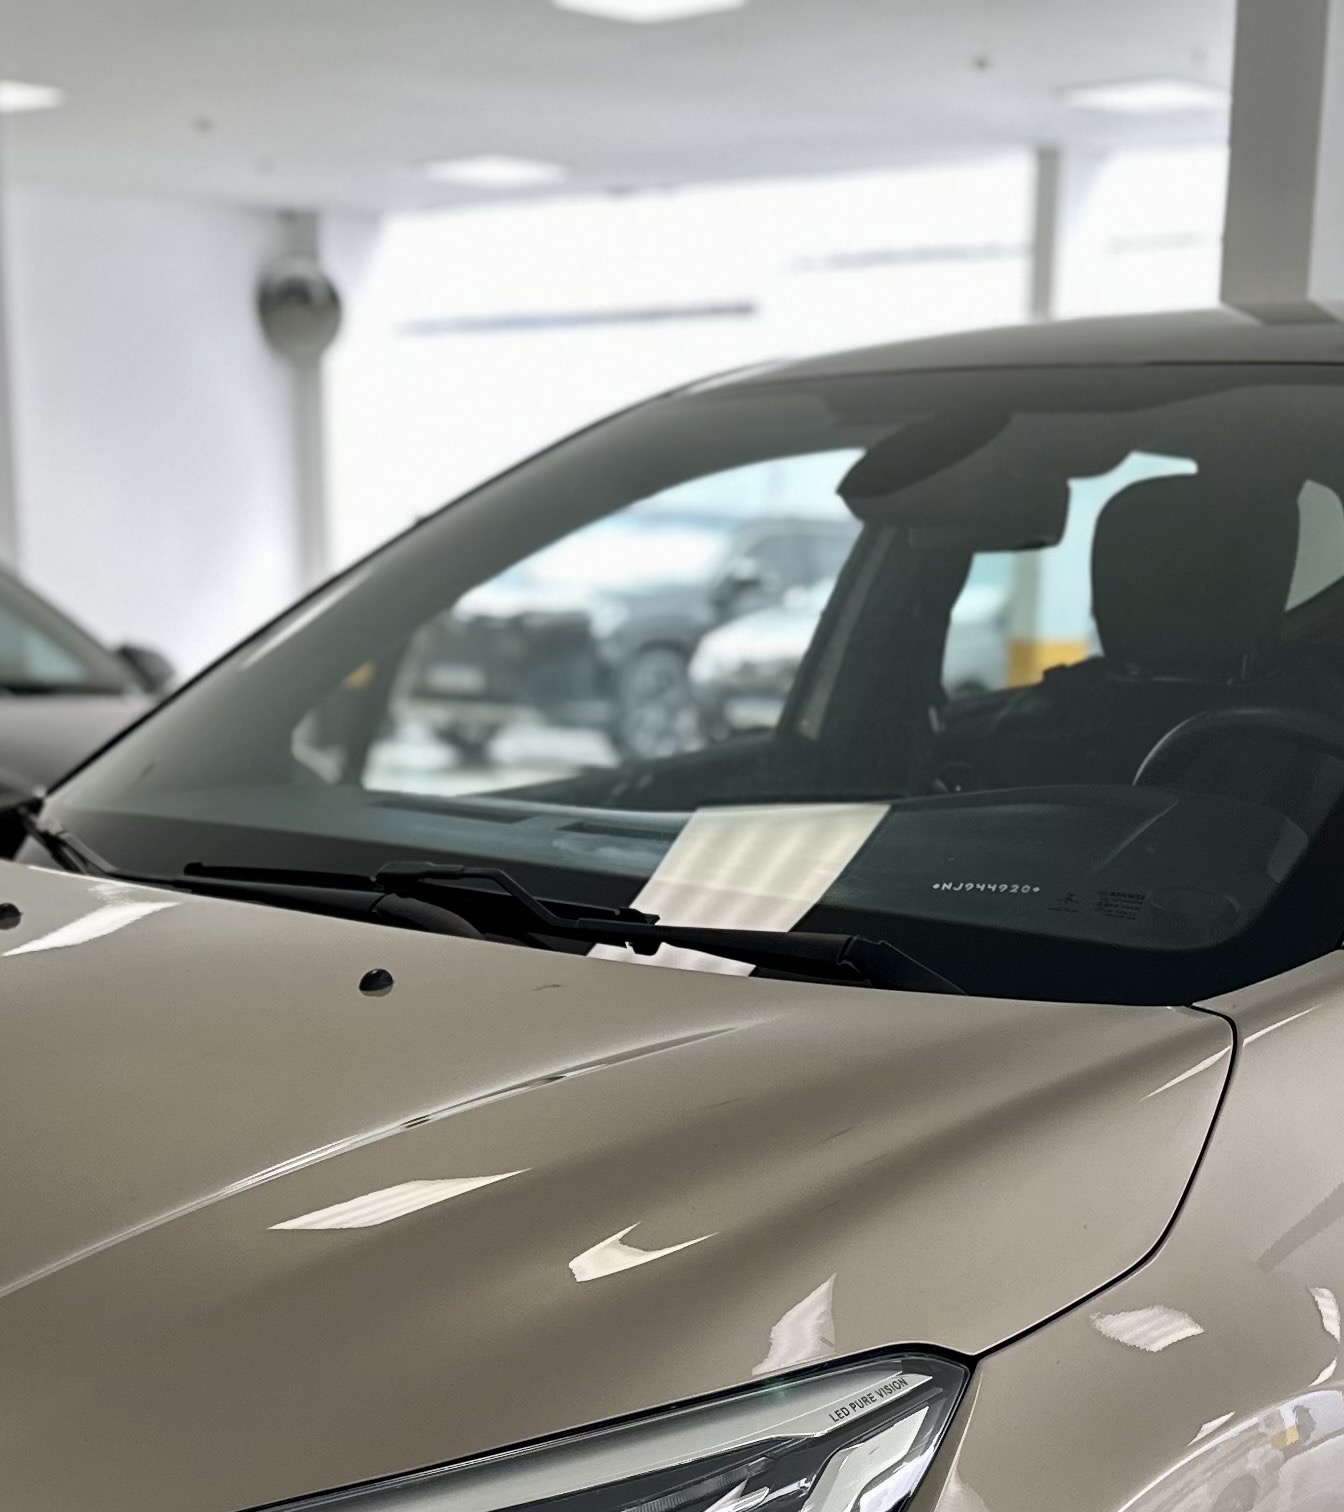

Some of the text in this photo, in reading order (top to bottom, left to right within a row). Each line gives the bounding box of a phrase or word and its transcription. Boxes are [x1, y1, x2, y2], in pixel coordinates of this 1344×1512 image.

[829, 1377, 909, 1423] LED PURE VISION
